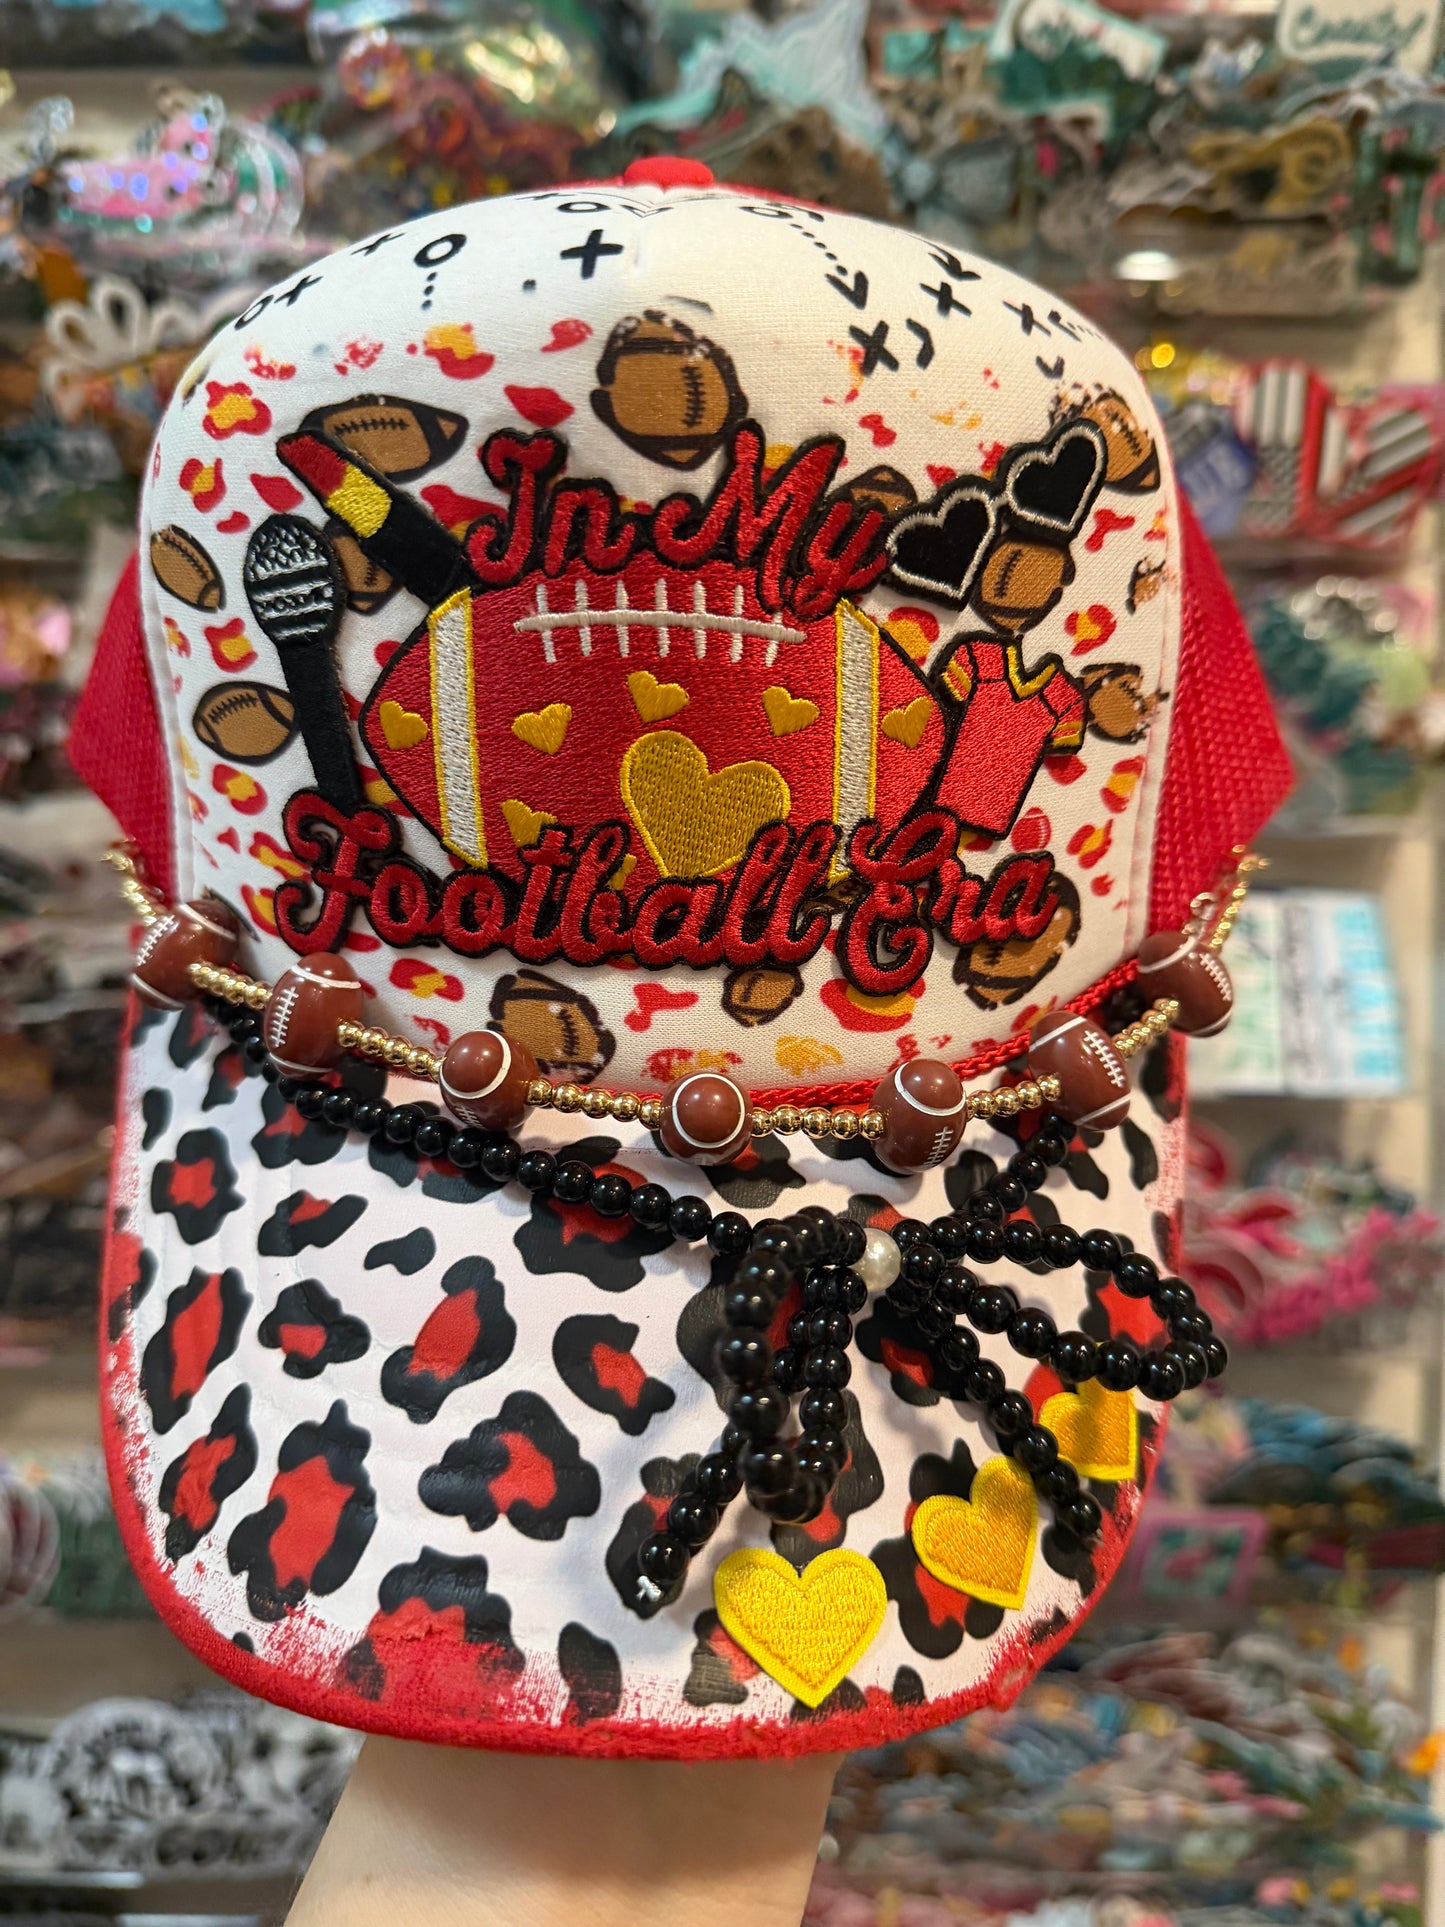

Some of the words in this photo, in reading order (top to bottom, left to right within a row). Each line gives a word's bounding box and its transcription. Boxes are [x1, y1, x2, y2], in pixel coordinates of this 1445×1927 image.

[465, 433, 637, 584] In
[652, 427, 889, 620] My
[275, 791, 831, 967] Football
[846, 809, 1060, 993] Era
